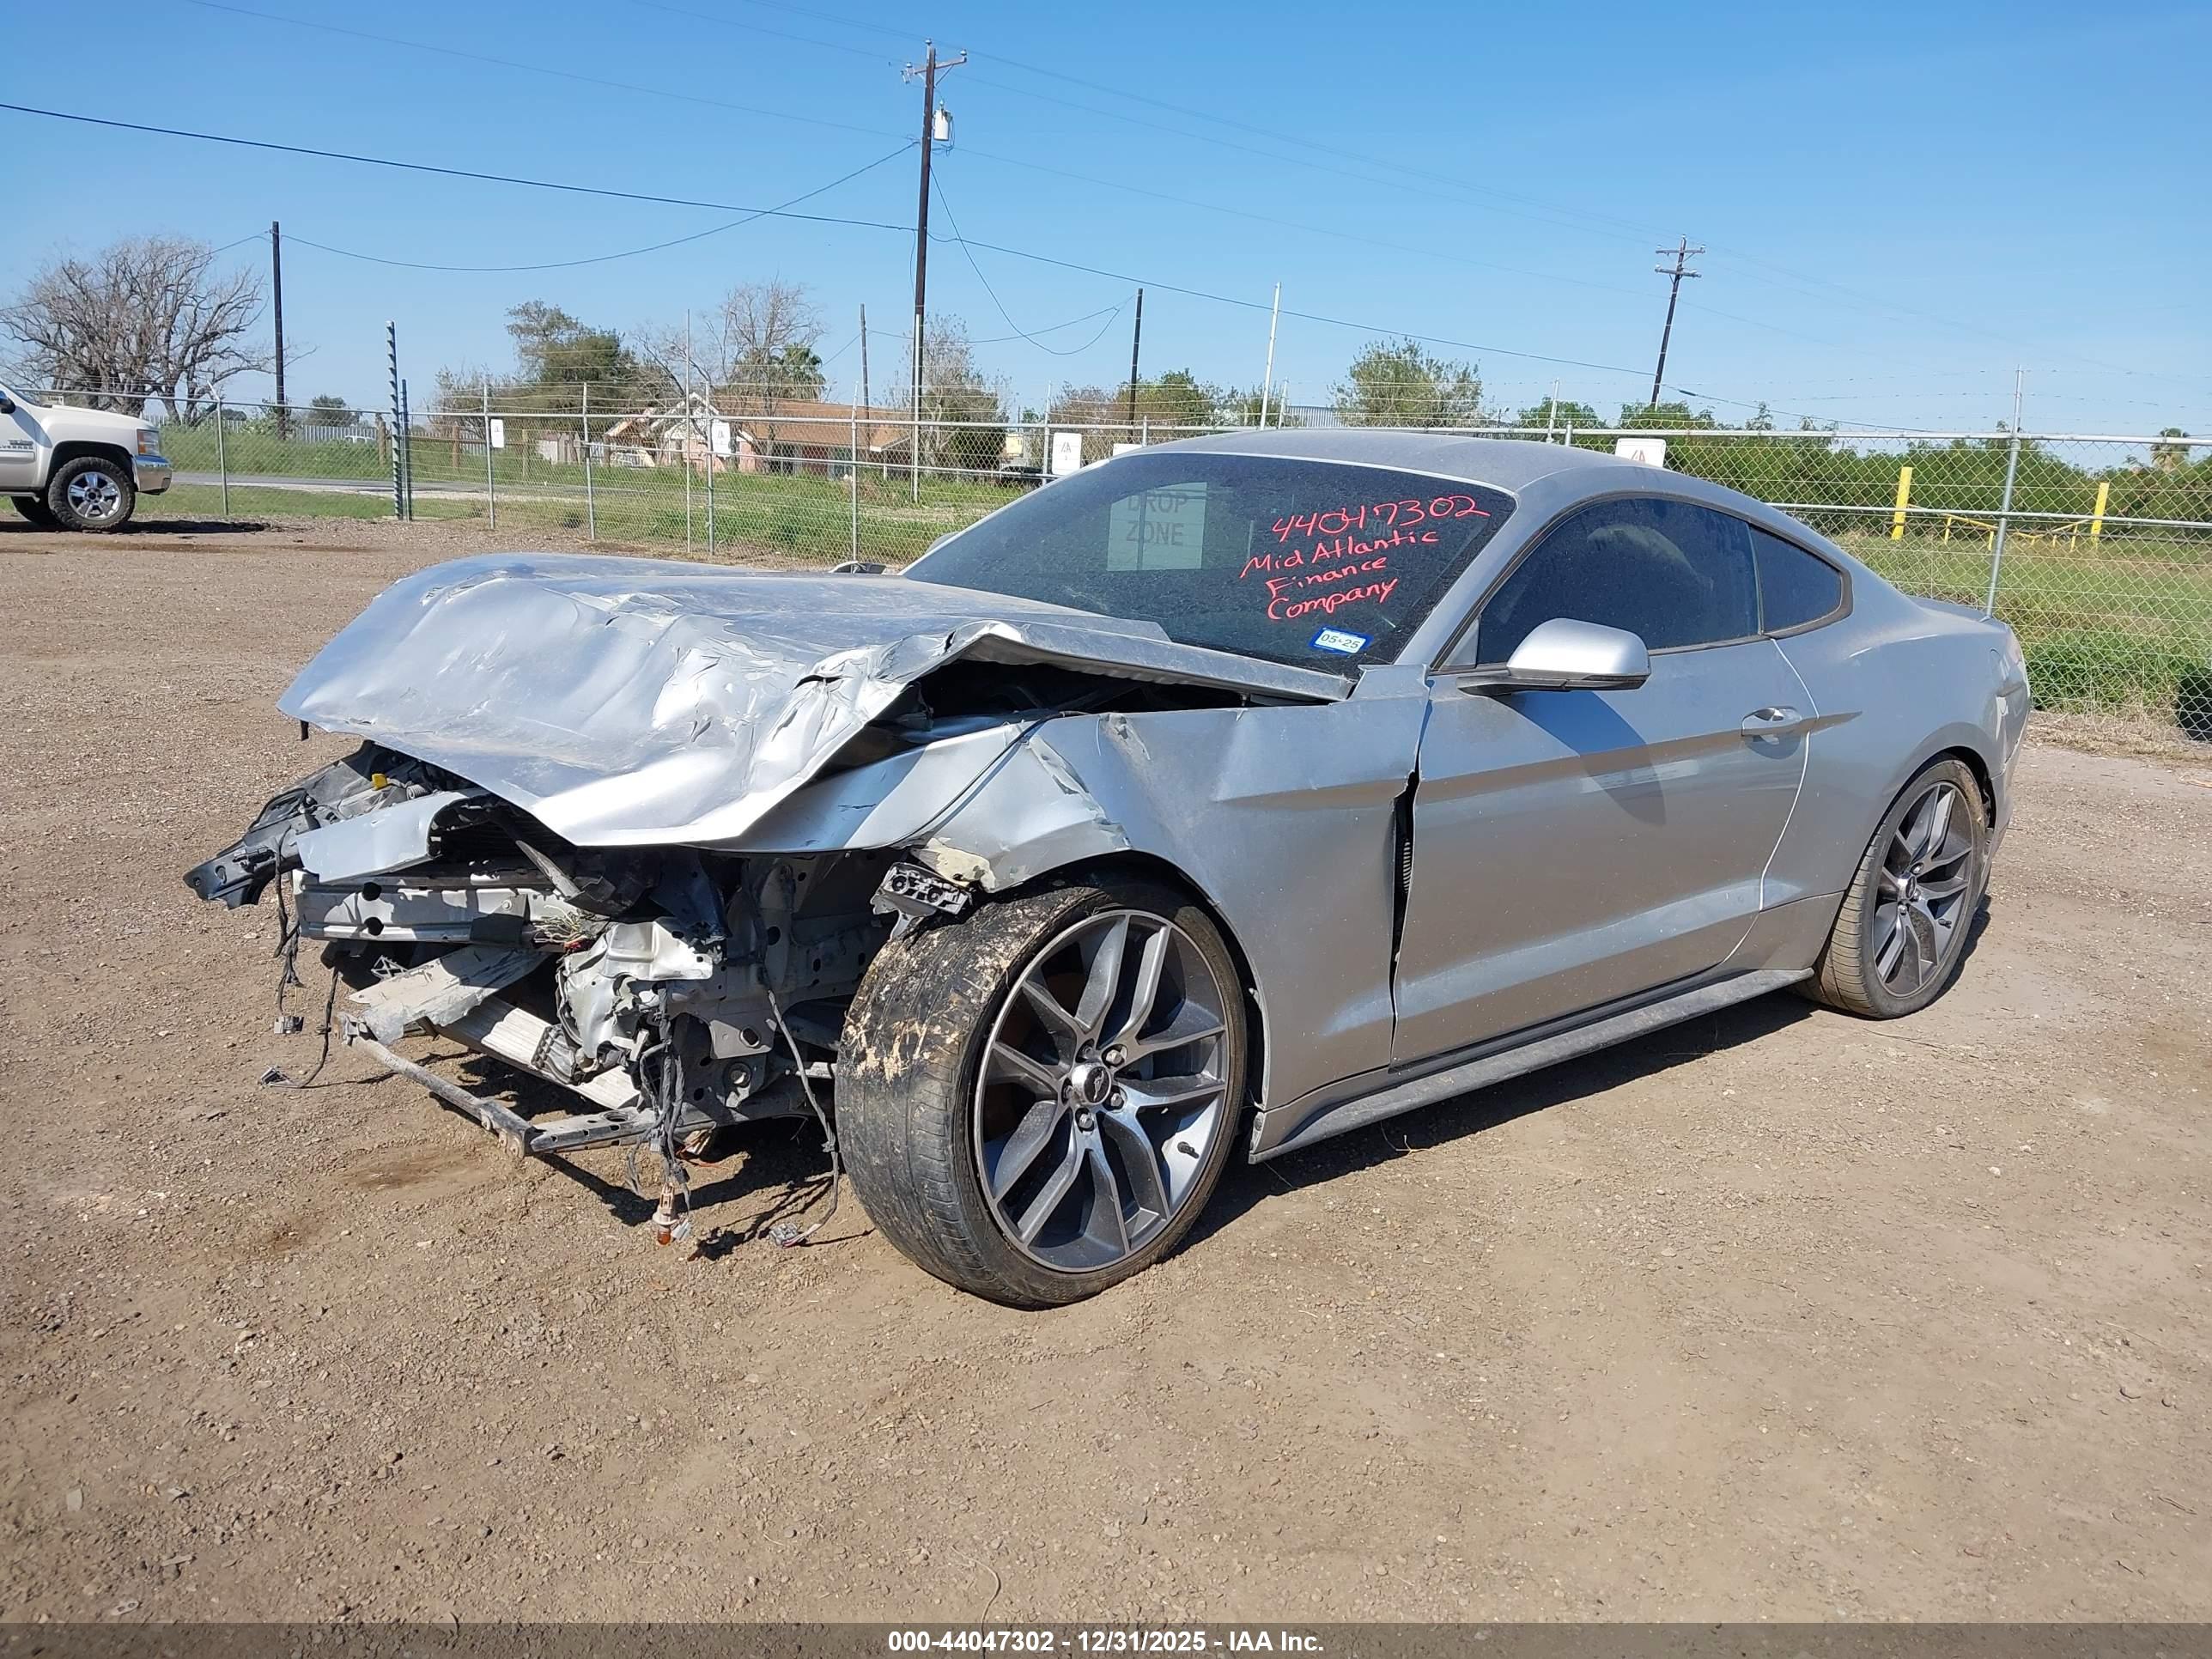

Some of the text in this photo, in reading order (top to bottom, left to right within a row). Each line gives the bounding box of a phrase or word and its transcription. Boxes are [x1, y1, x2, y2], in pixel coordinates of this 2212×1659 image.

[1127, 494, 1187, 514] DROP
[1126, 521, 1184, 546] ZONE
[1239, 529, 1439, 578] Mid Atlantic
[1265, 556, 1388, 599] Finance
[1267, 578, 1398, 620] Company
